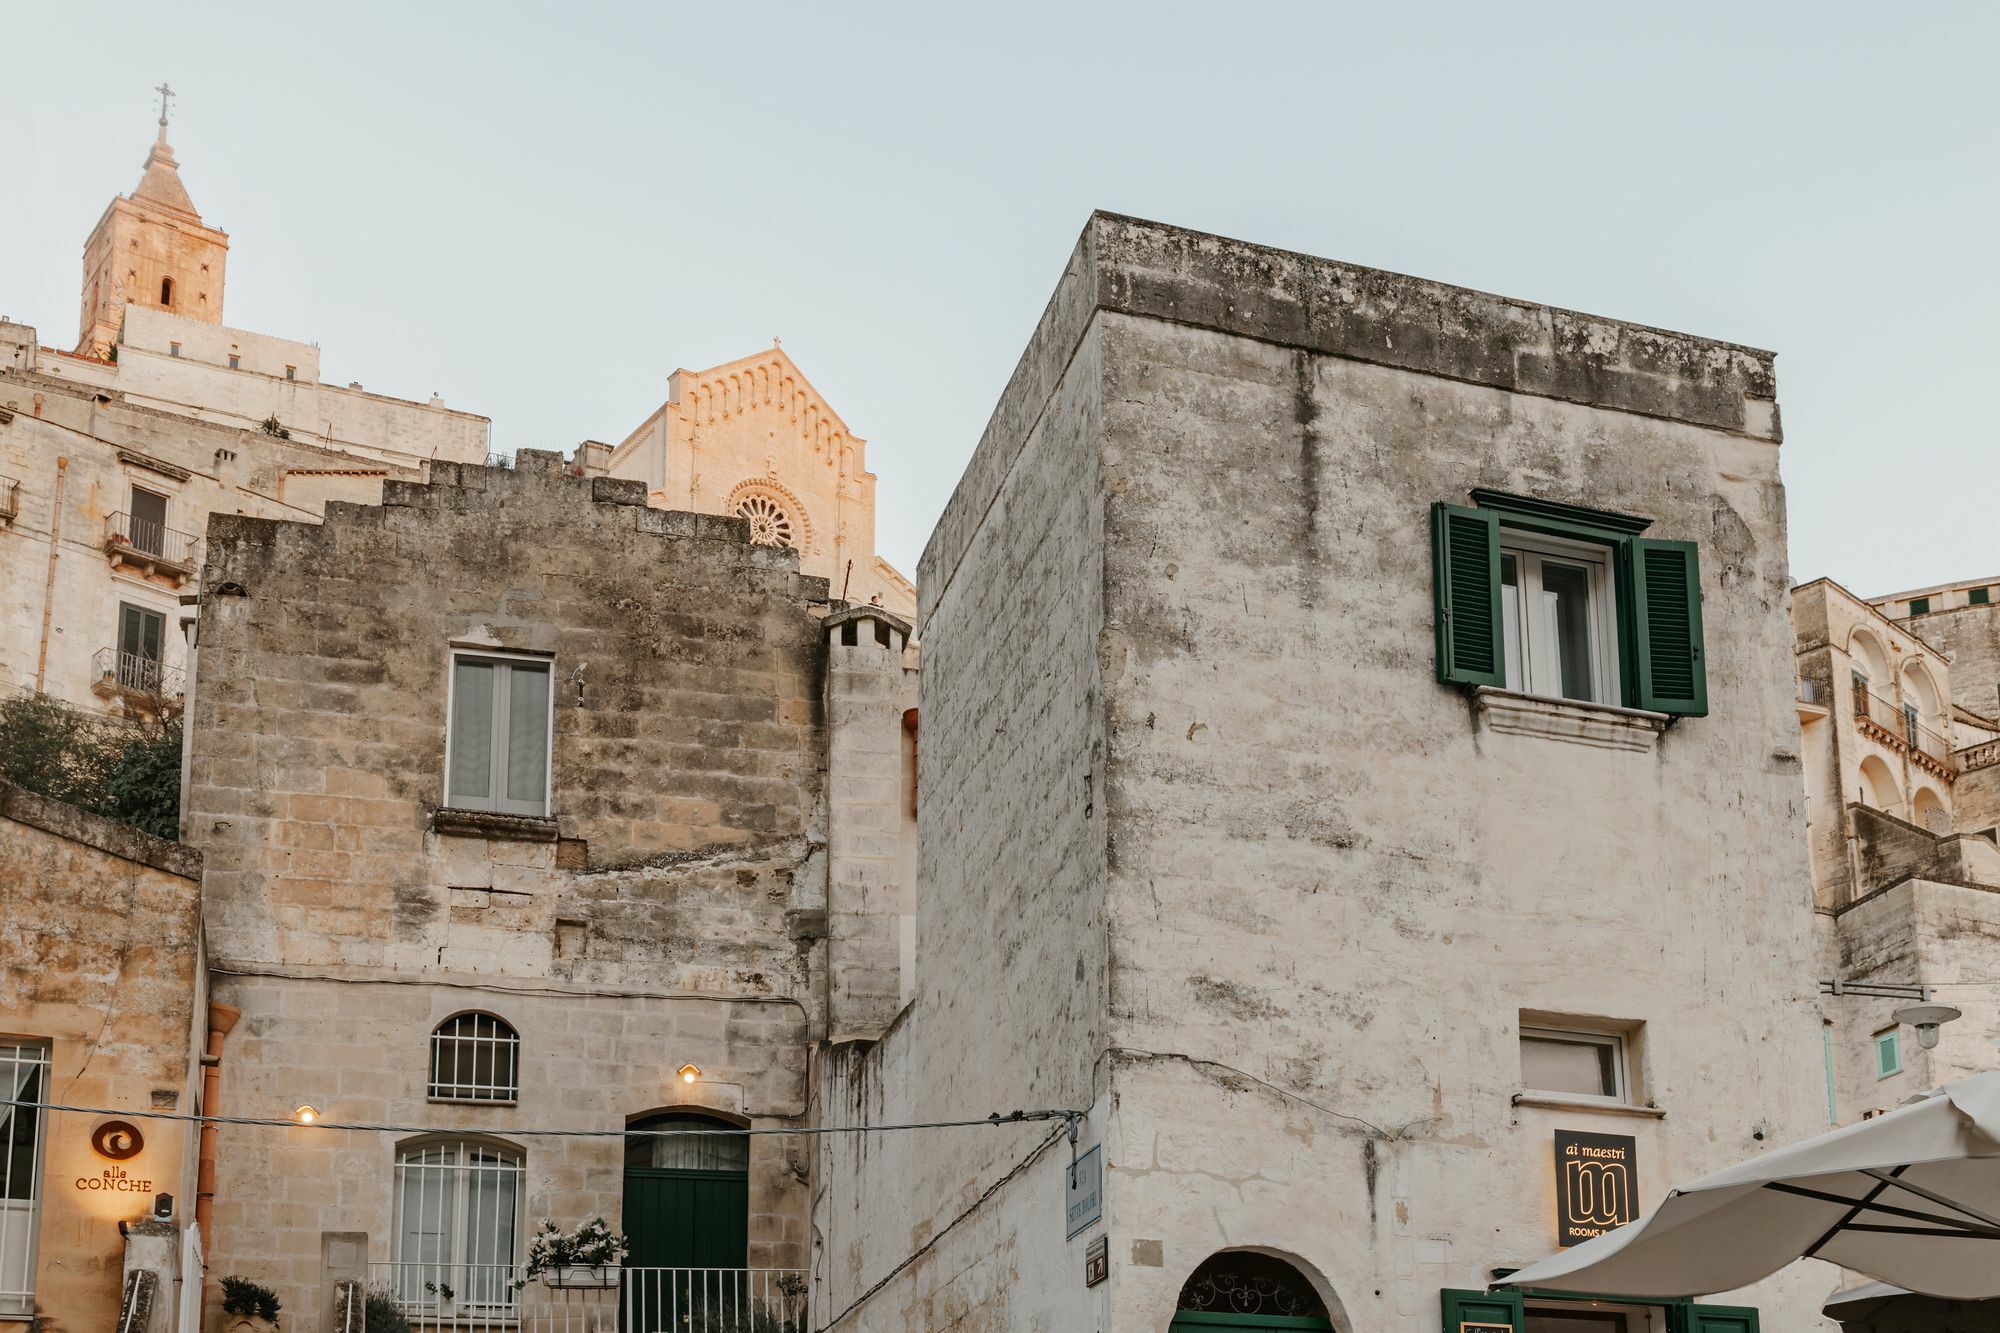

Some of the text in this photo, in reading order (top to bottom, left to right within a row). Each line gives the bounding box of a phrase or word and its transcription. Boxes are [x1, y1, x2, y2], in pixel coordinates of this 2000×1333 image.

[1565, 1143, 1626, 1160] ai maestri
[103, 1165, 127, 1179] alle
[75, 1177, 152, 1193] CONCHE
[1569, 1227, 1600, 1238] ROOMS
